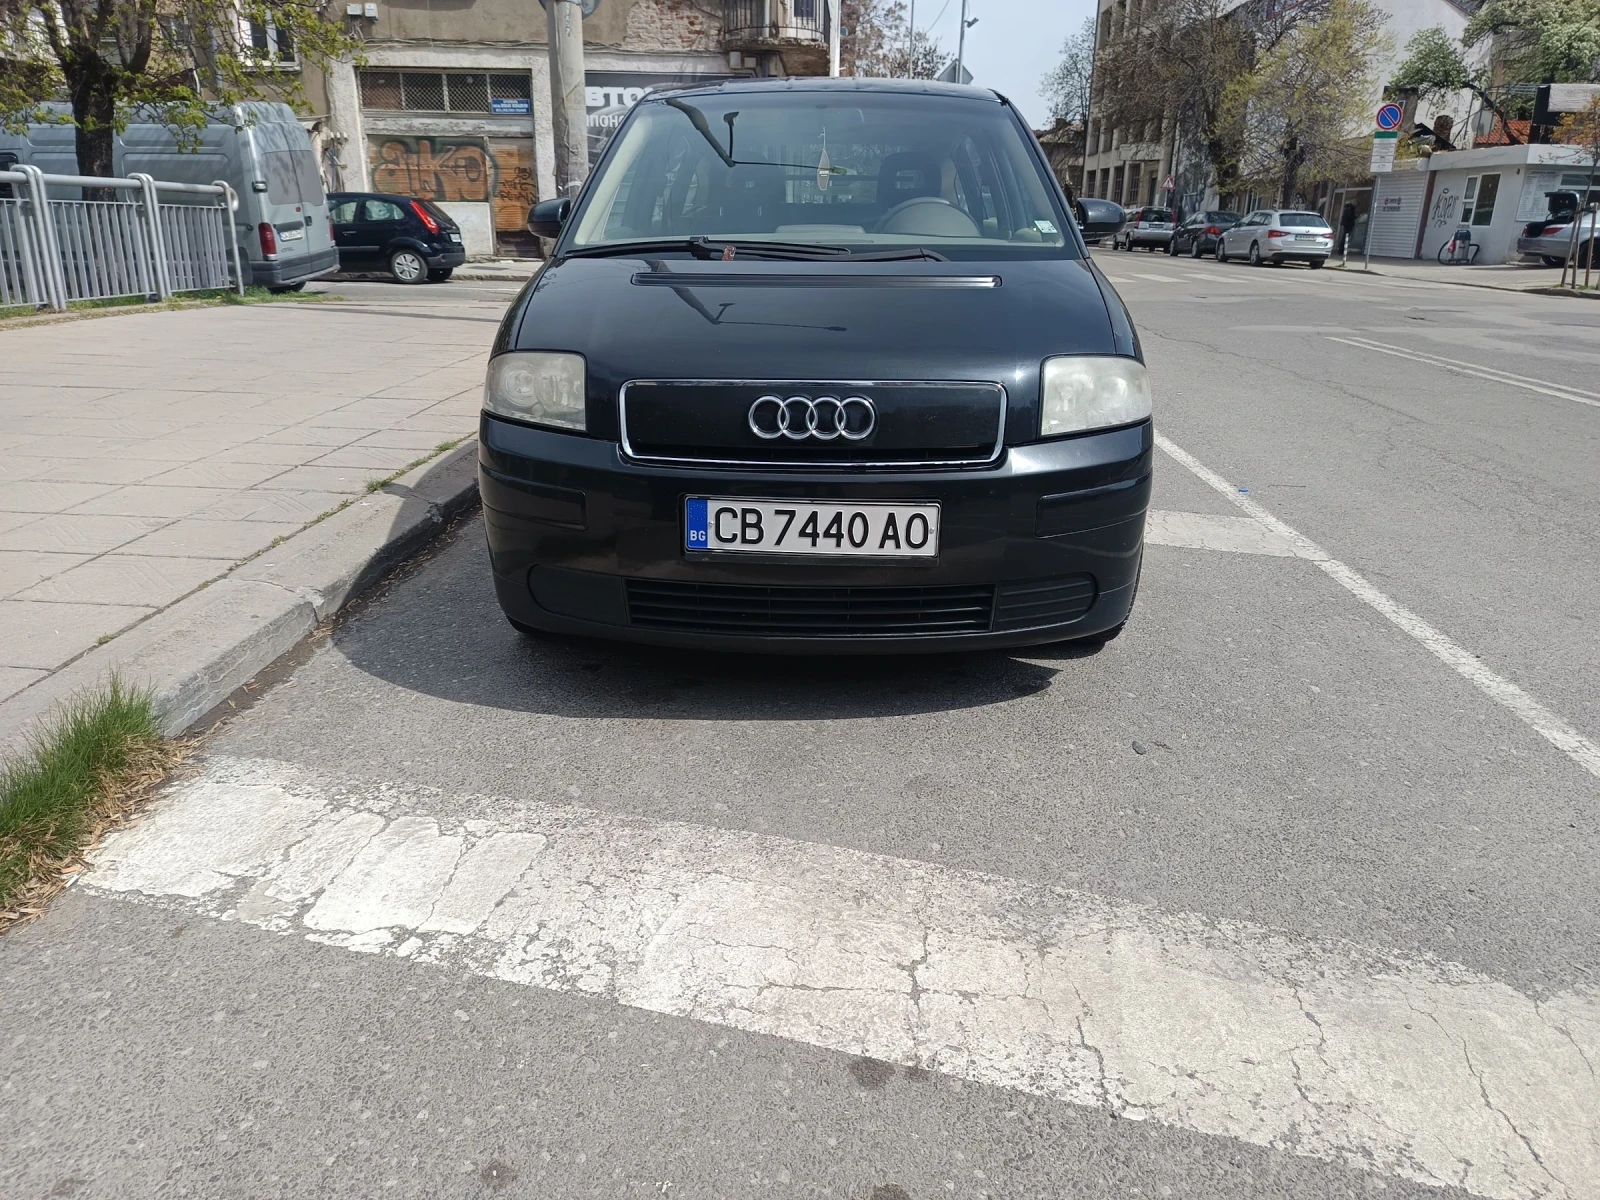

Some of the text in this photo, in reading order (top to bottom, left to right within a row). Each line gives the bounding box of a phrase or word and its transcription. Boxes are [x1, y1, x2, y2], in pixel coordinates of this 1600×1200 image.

[689, 530, 706, 542] BG
[714, 507, 930, 550] CB 7440 AO
